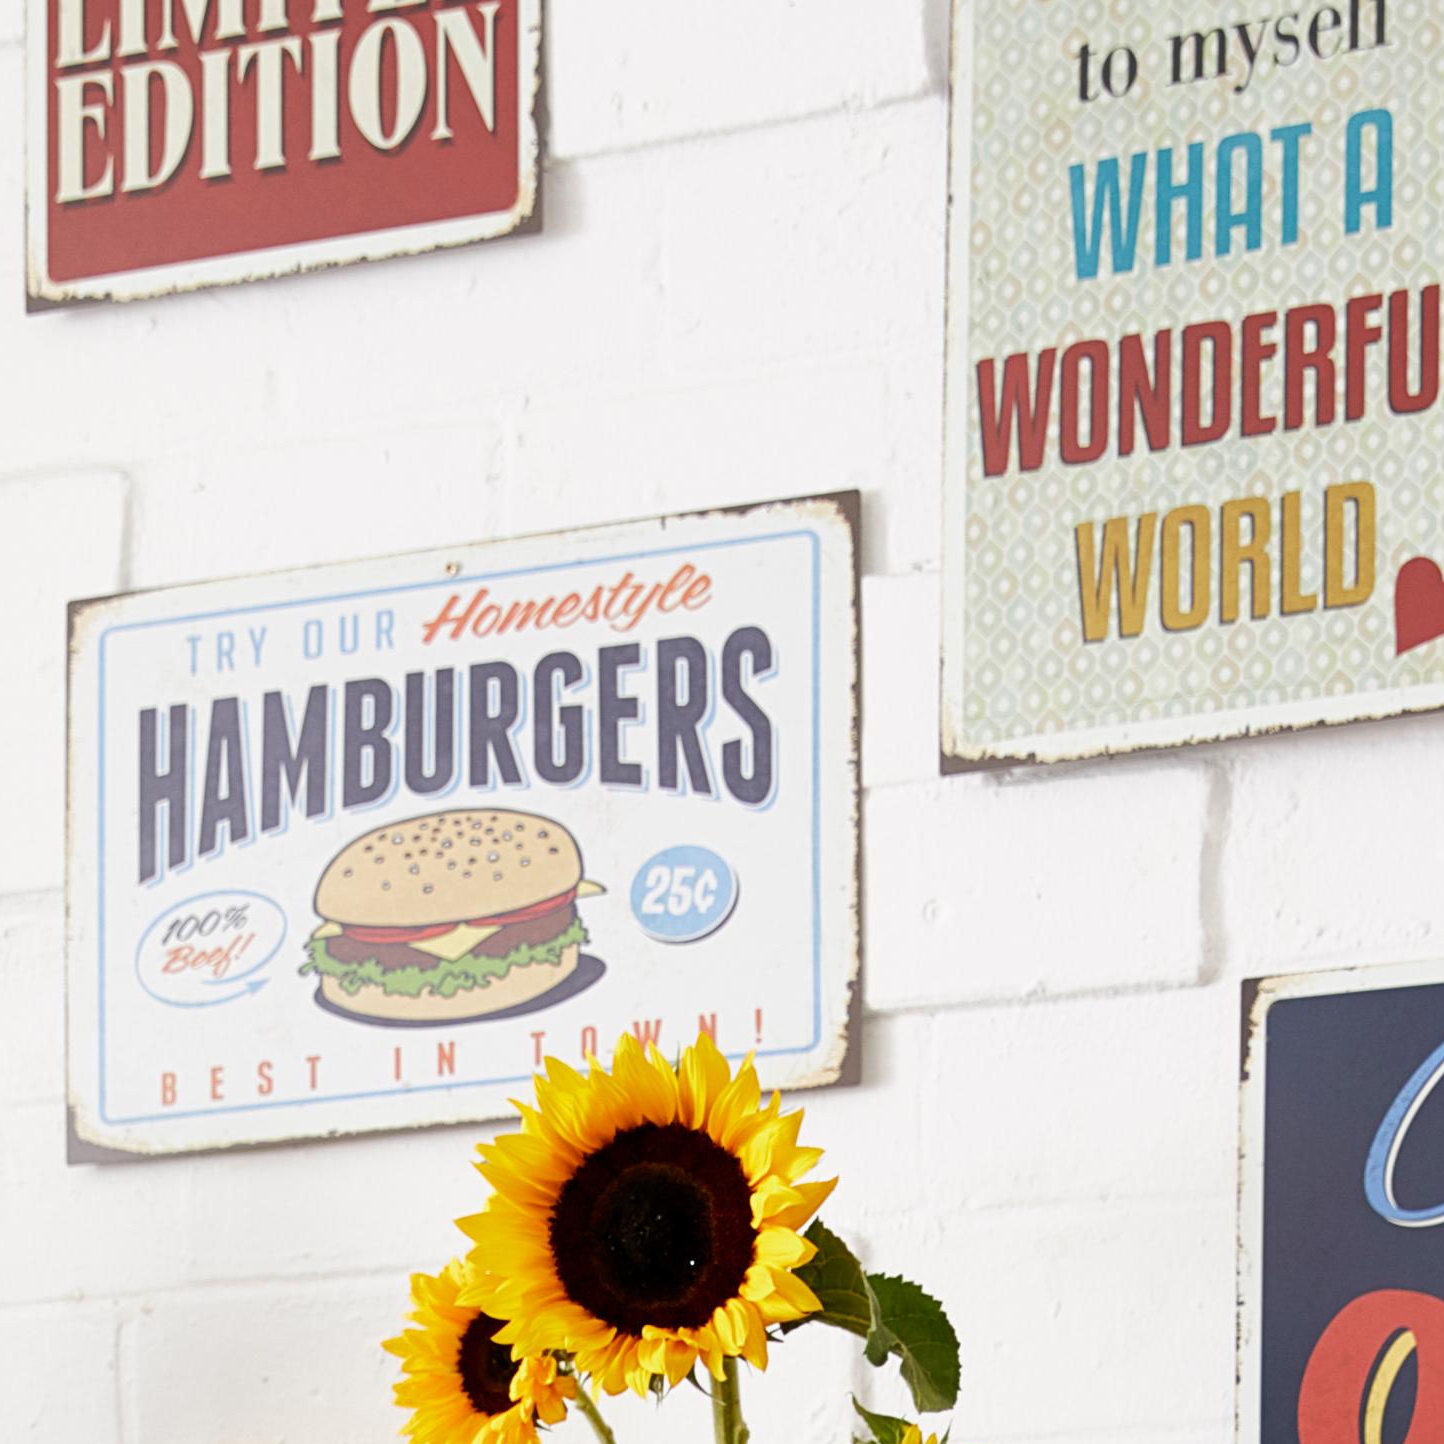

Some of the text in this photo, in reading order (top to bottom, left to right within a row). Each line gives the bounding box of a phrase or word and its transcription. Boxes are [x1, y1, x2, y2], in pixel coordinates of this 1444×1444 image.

[56, 2, 501, 204] EDITION
[1076, 43, 1138, 104] to
[1068, 108, 1393, 282] WHAT A
[1074, 480, 1377, 645] WORLD
[187, 562, 714, 676] TRY OUR Homestyle
[138, 625, 780, 887] HAMBURGERS
[161, 903, 251, 946] 100%
[641, 864, 717, 916] 25¢
[161, 932, 256, 978] Beef!
[161, 1056, 322, 1107] BEST
[394, 1041, 457, 1081] IN
